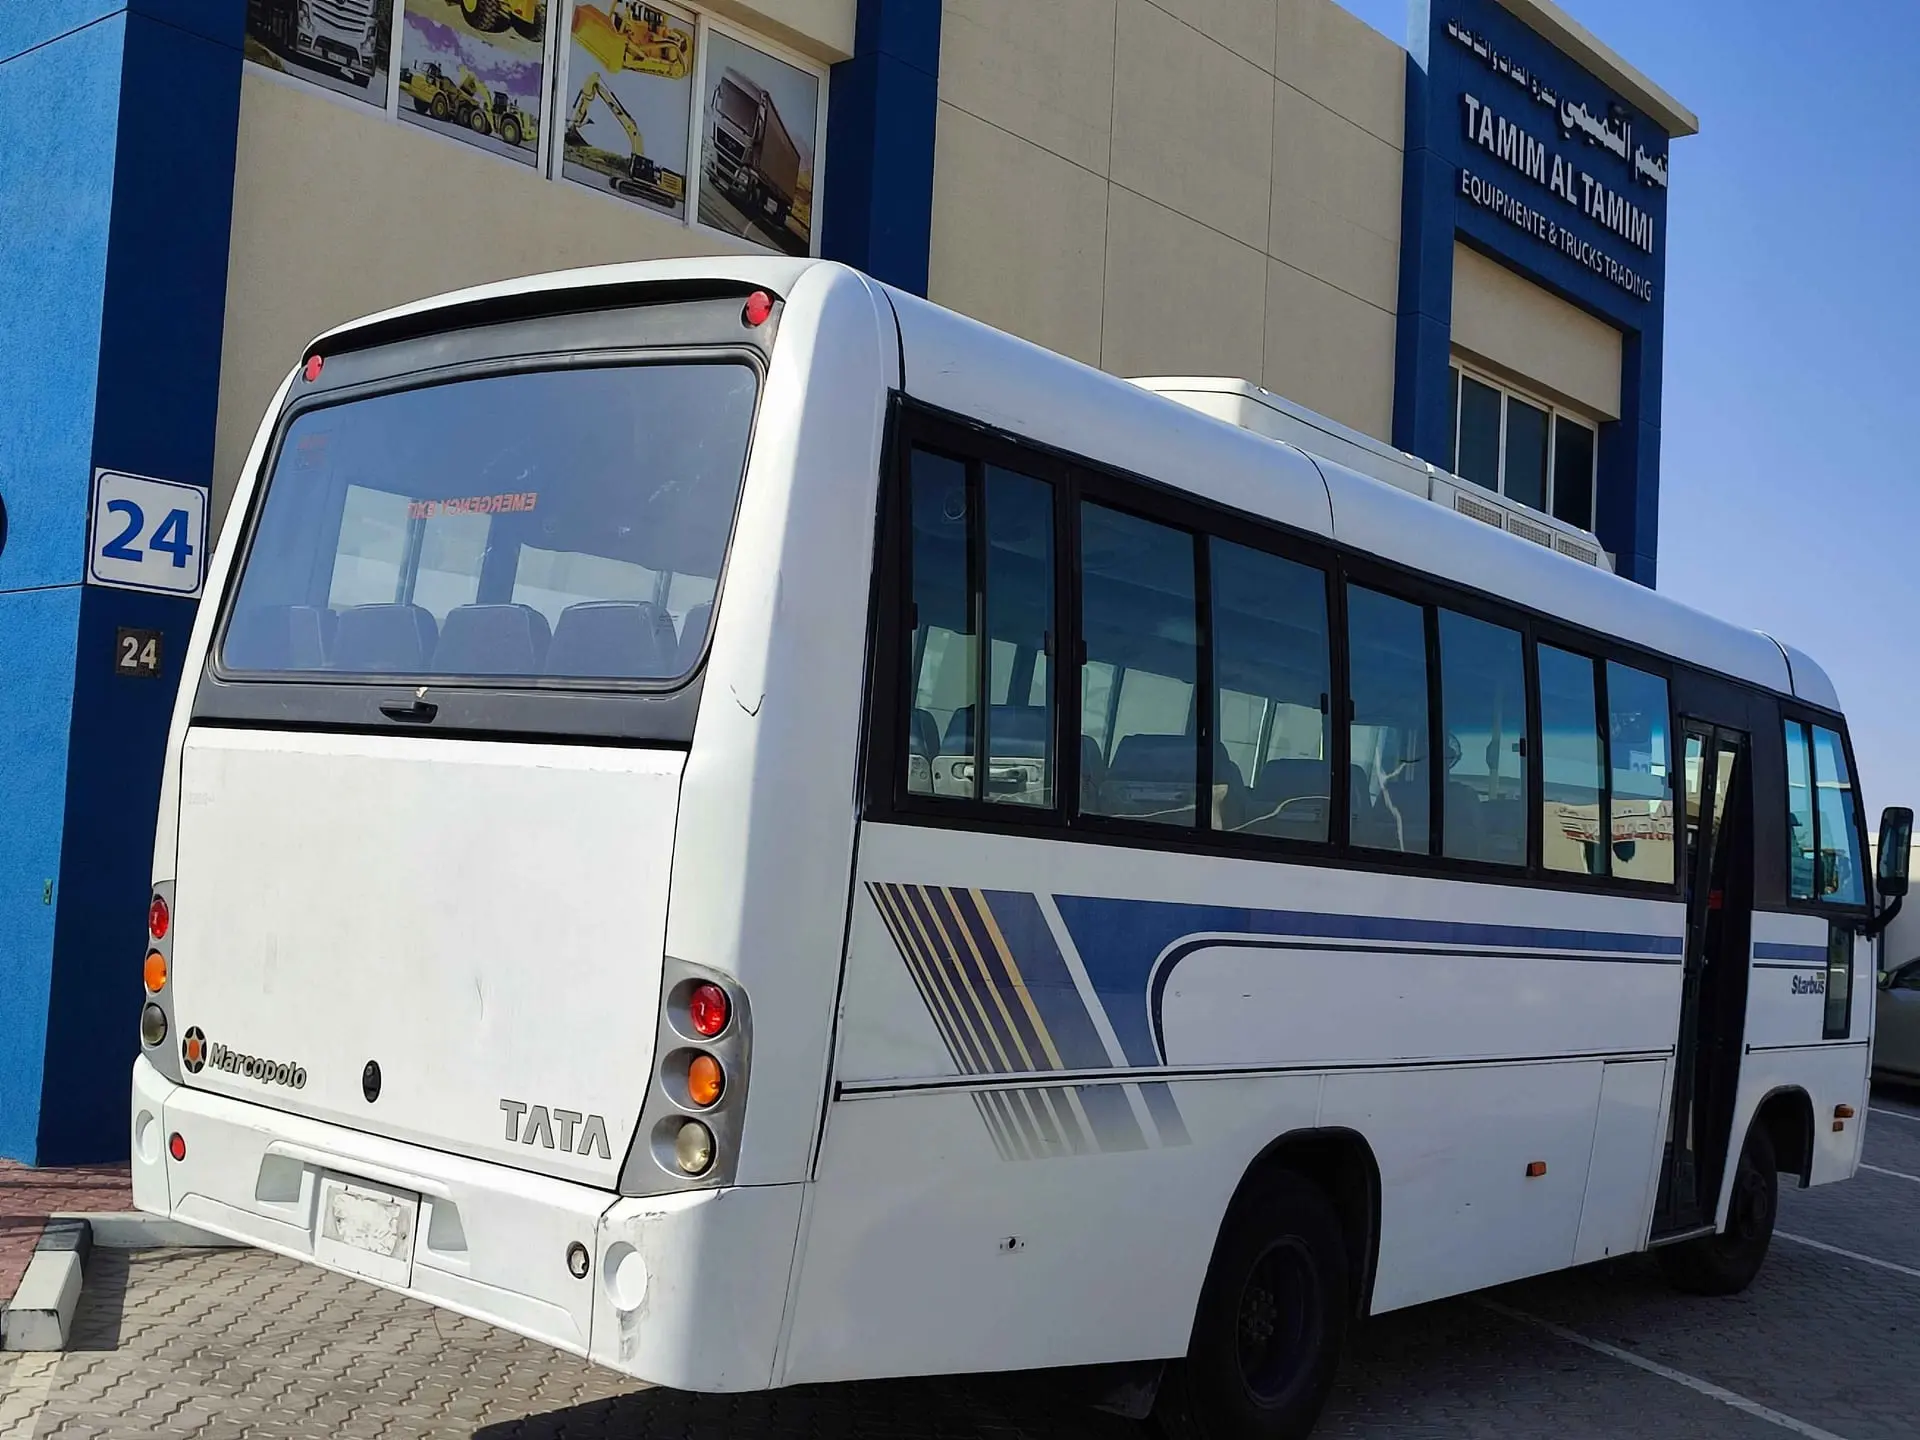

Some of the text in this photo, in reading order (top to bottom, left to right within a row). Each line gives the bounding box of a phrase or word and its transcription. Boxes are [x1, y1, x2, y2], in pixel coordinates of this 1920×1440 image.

[1561, 98, 1631, 162] التميمي
[1465, 92, 1653, 254] TAMIM AL TAMIMI
[1635, 143, 1667, 187] تميم
[1462, 168, 1652, 302] EQUIPMENTE & TRUCKS TRADING
[102, 499, 193, 568] 24
[120, 636, 157, 669] 24
[1791, 974, 1825, 995] Starbus
[208, 1042, 307, 1090] Marcopolo
[500, 1098, 611, 1159] TATA
